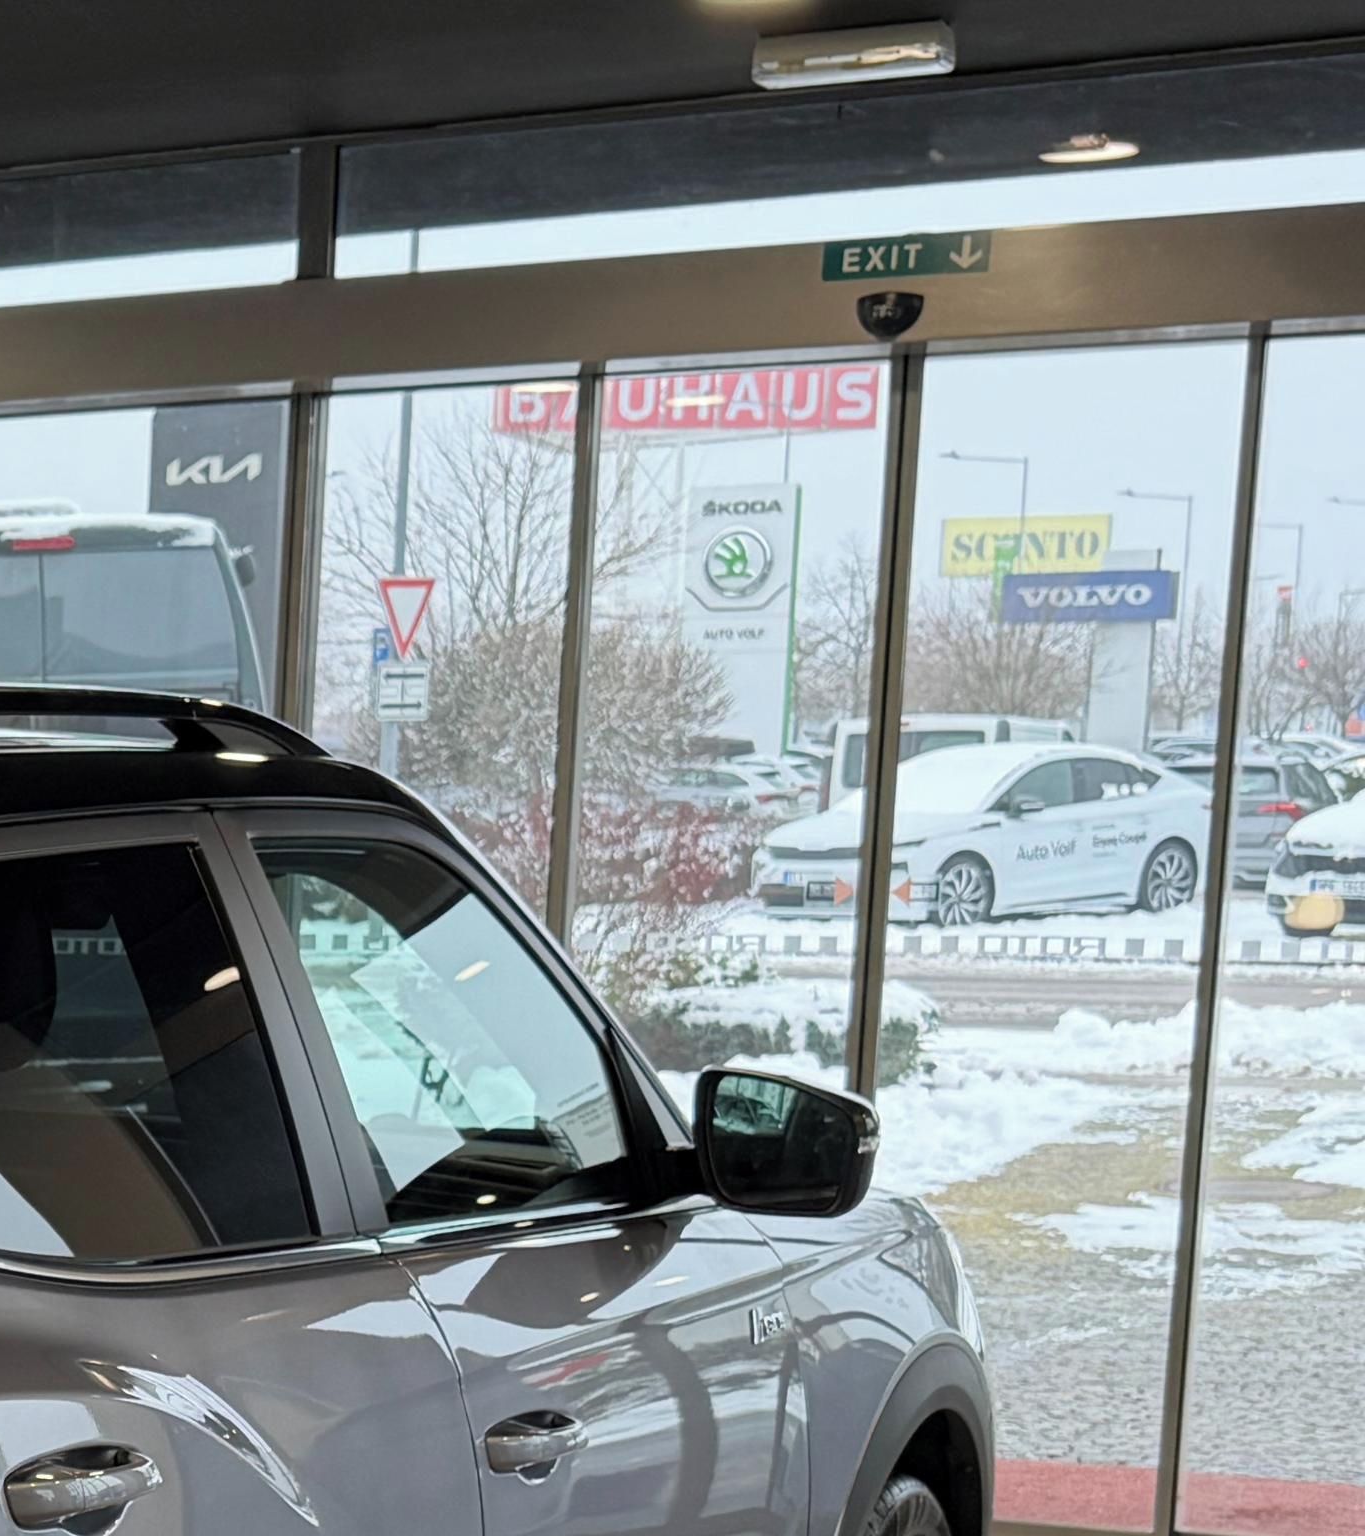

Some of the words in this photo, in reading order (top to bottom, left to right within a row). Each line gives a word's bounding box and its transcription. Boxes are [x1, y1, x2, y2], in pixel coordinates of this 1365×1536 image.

[842, 243, 923, 273] EXIT
[165, 452, 263, 487] KIA
[702, 499, 783, 517] ŠKODA
[950, 529, 1100, 562] SCNTO
[1017, 583, 1153, 609] VOLVO
[703, 628, 734, 641] AUTO
[1016, 844, 1049, 862] Auto
